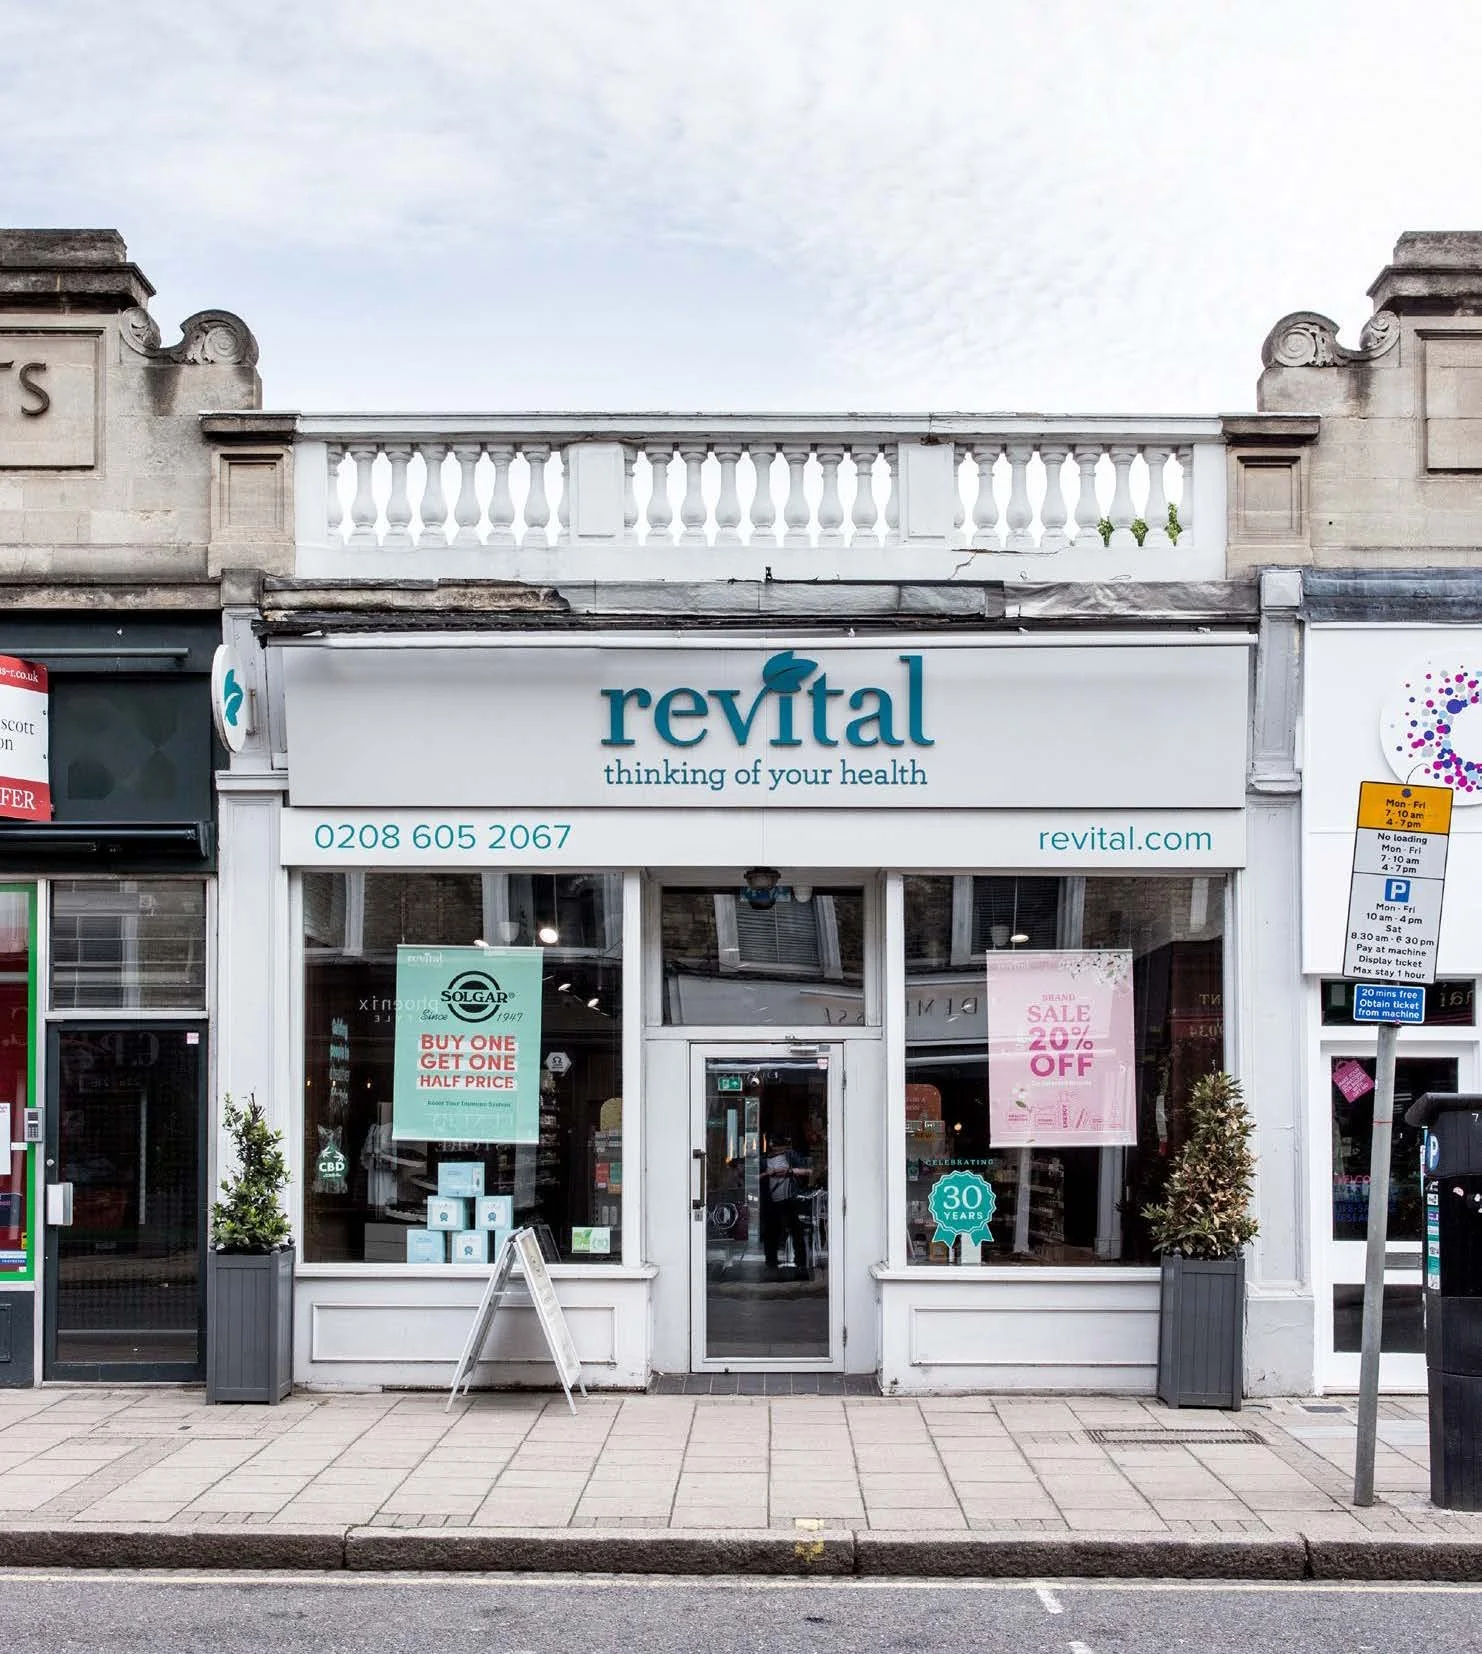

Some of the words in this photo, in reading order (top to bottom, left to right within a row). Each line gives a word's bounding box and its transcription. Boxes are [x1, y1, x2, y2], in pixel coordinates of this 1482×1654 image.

[0, 361, 50, 416] S
[0, 667, 38, 682] s-r.co.uk
[600, 650, 935, 747] revital
[1, 719, 35, 735] scott
[604, 758, 726, 791] thinking
[735, 760, 762, 785] of
[769, 768, 832, 791] your
[840, 758, 928, 785] health
[1386, 799, 1406, 807] Mon
[1413, 801, 1426, 809] Fri
[315, 824, 400, 849] 0208
[412, 824, 476, 849] 605
[488, 824, 571, 849] 2067
[1040, 826, 1212, 851] revital.com
[1377, 832, 1391, 841] No
[1394, 834, 1428, 845] loading
[1381, 844, 1401, 853] Mon
[1391, 882, 1406, 899] P
[1376, 903, 1395, 911] Mon
[1403, 905, 1416, 913] Fri
[1386, 925, 1402, 933] Sat
[1420, 938, 1435, 946] pm
[1356, 944, 1373, 953] Pay
[1388, 947, 1427, 957] machine
[1359, 955, 1392, 966] Display
[1395, 958, 1422, 967] ticket
[1353, 966, 1372, 975] Max
[1375, 969, 1394, 978] stay
[1404, 971, 1426, 979] hour
[1376, 989, 1396, 997] mins
[1400, 990, 1418, 998] free
[1359, 999, 1390, 1008] Obtain
[1393, 1000, 1419, 1009] ticket
[420, 1009, 448, 1021] Since
[496, 1010, 524, 1022] 1947
[1027, 1005, 1091, 1023] SALE
[1358, 1008, 1379, 1016] from
[1382, 1009, 1420, 1018] machine
[421, 1034, 465, 1050] BUY
[470, 1035, 516, 1051] ONE
[1029, 1025, 1093, 1051] 20%
[420, 1053, 463, 1070] GET
[469, 1054, 516, 1071] ONE
[1030, 1053, 1094, 1077] OFF
[420, 1075, 461, 1088] HALF
[465, 1075, 514, 1089] PRICE
[319, 1162, 345, 1172] CBD
[943, 1185, 982, 1210] 30
[944, 1212, 984, 1220] YEARS
